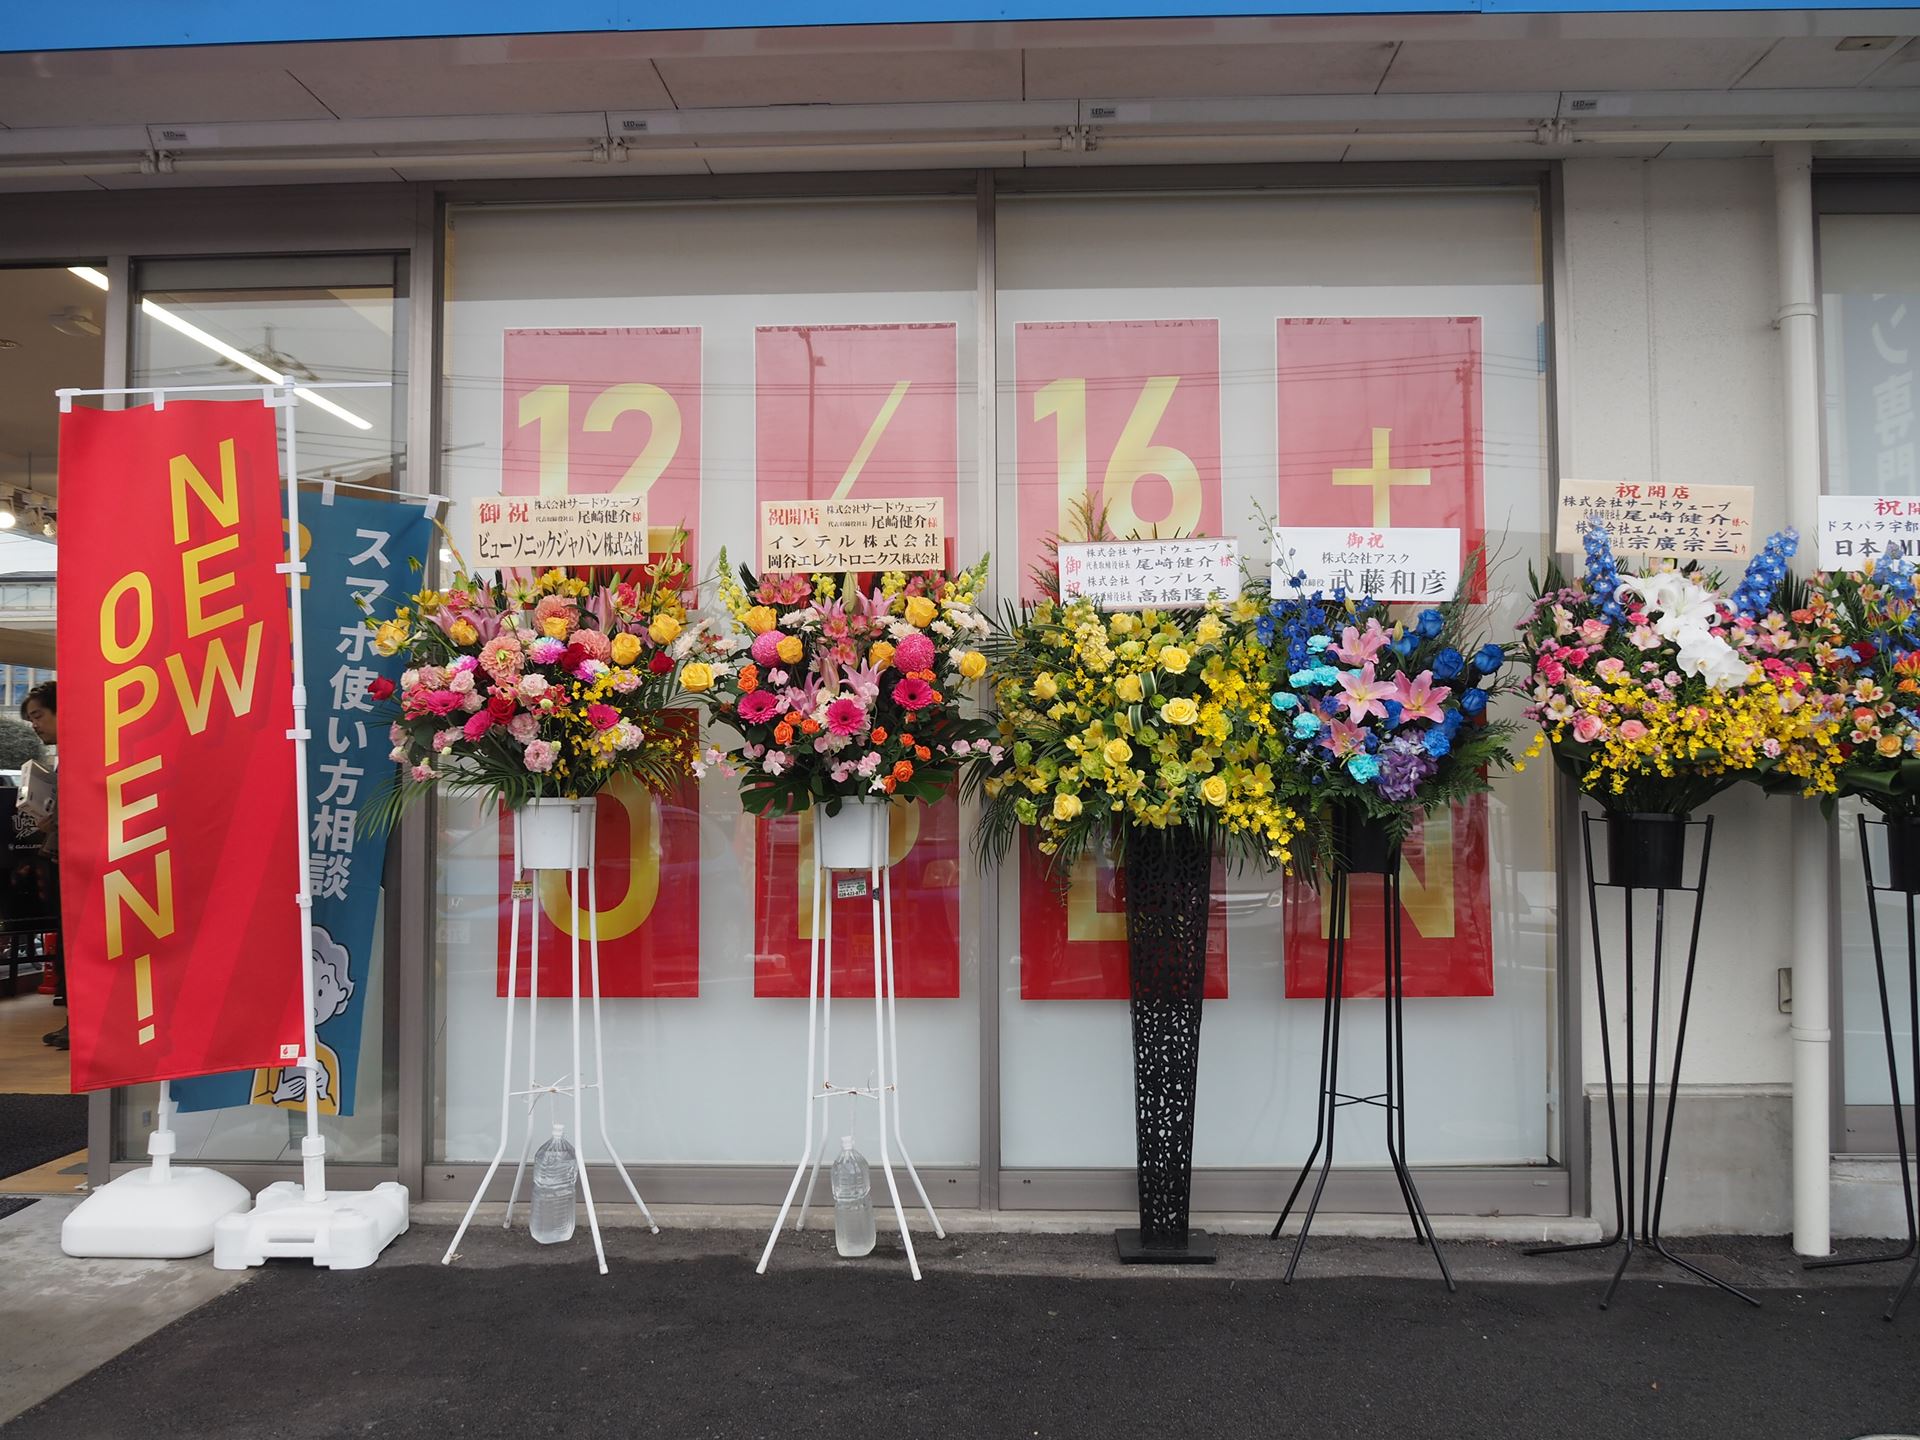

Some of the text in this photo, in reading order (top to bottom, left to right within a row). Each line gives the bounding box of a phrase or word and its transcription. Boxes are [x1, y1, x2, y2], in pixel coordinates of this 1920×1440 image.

[518, 383, 682, 553] 12
[1034, 376, 1202, 541] 16
[1616, 482, 1691, 500] 祝開店
[534, 496, 643, 510] 株式会社サードウェーブ
[826, 501, 937, 515] 株式会社サードウェーブ
[479, 502, 529, 524] 御祝
[768, 507, 820, 526] 祝開店
[1575, 520, 1743, 539] 株会社エム・エス・シー
[478, 529, 643, 560] ビューソニックジャパン株式会社
[1346, 531, 1384, 549] 御祝
[767, 552, 940, 569] 岡谷エレクトロニクス株式会社
[1322, 552, 1410, 565] 株式会社アスク
[165, 438, 263, 736] NEW
[309, 528, 392, 902] スマホ使い方相談
[100, 571, 175, 1045] OPEN!
